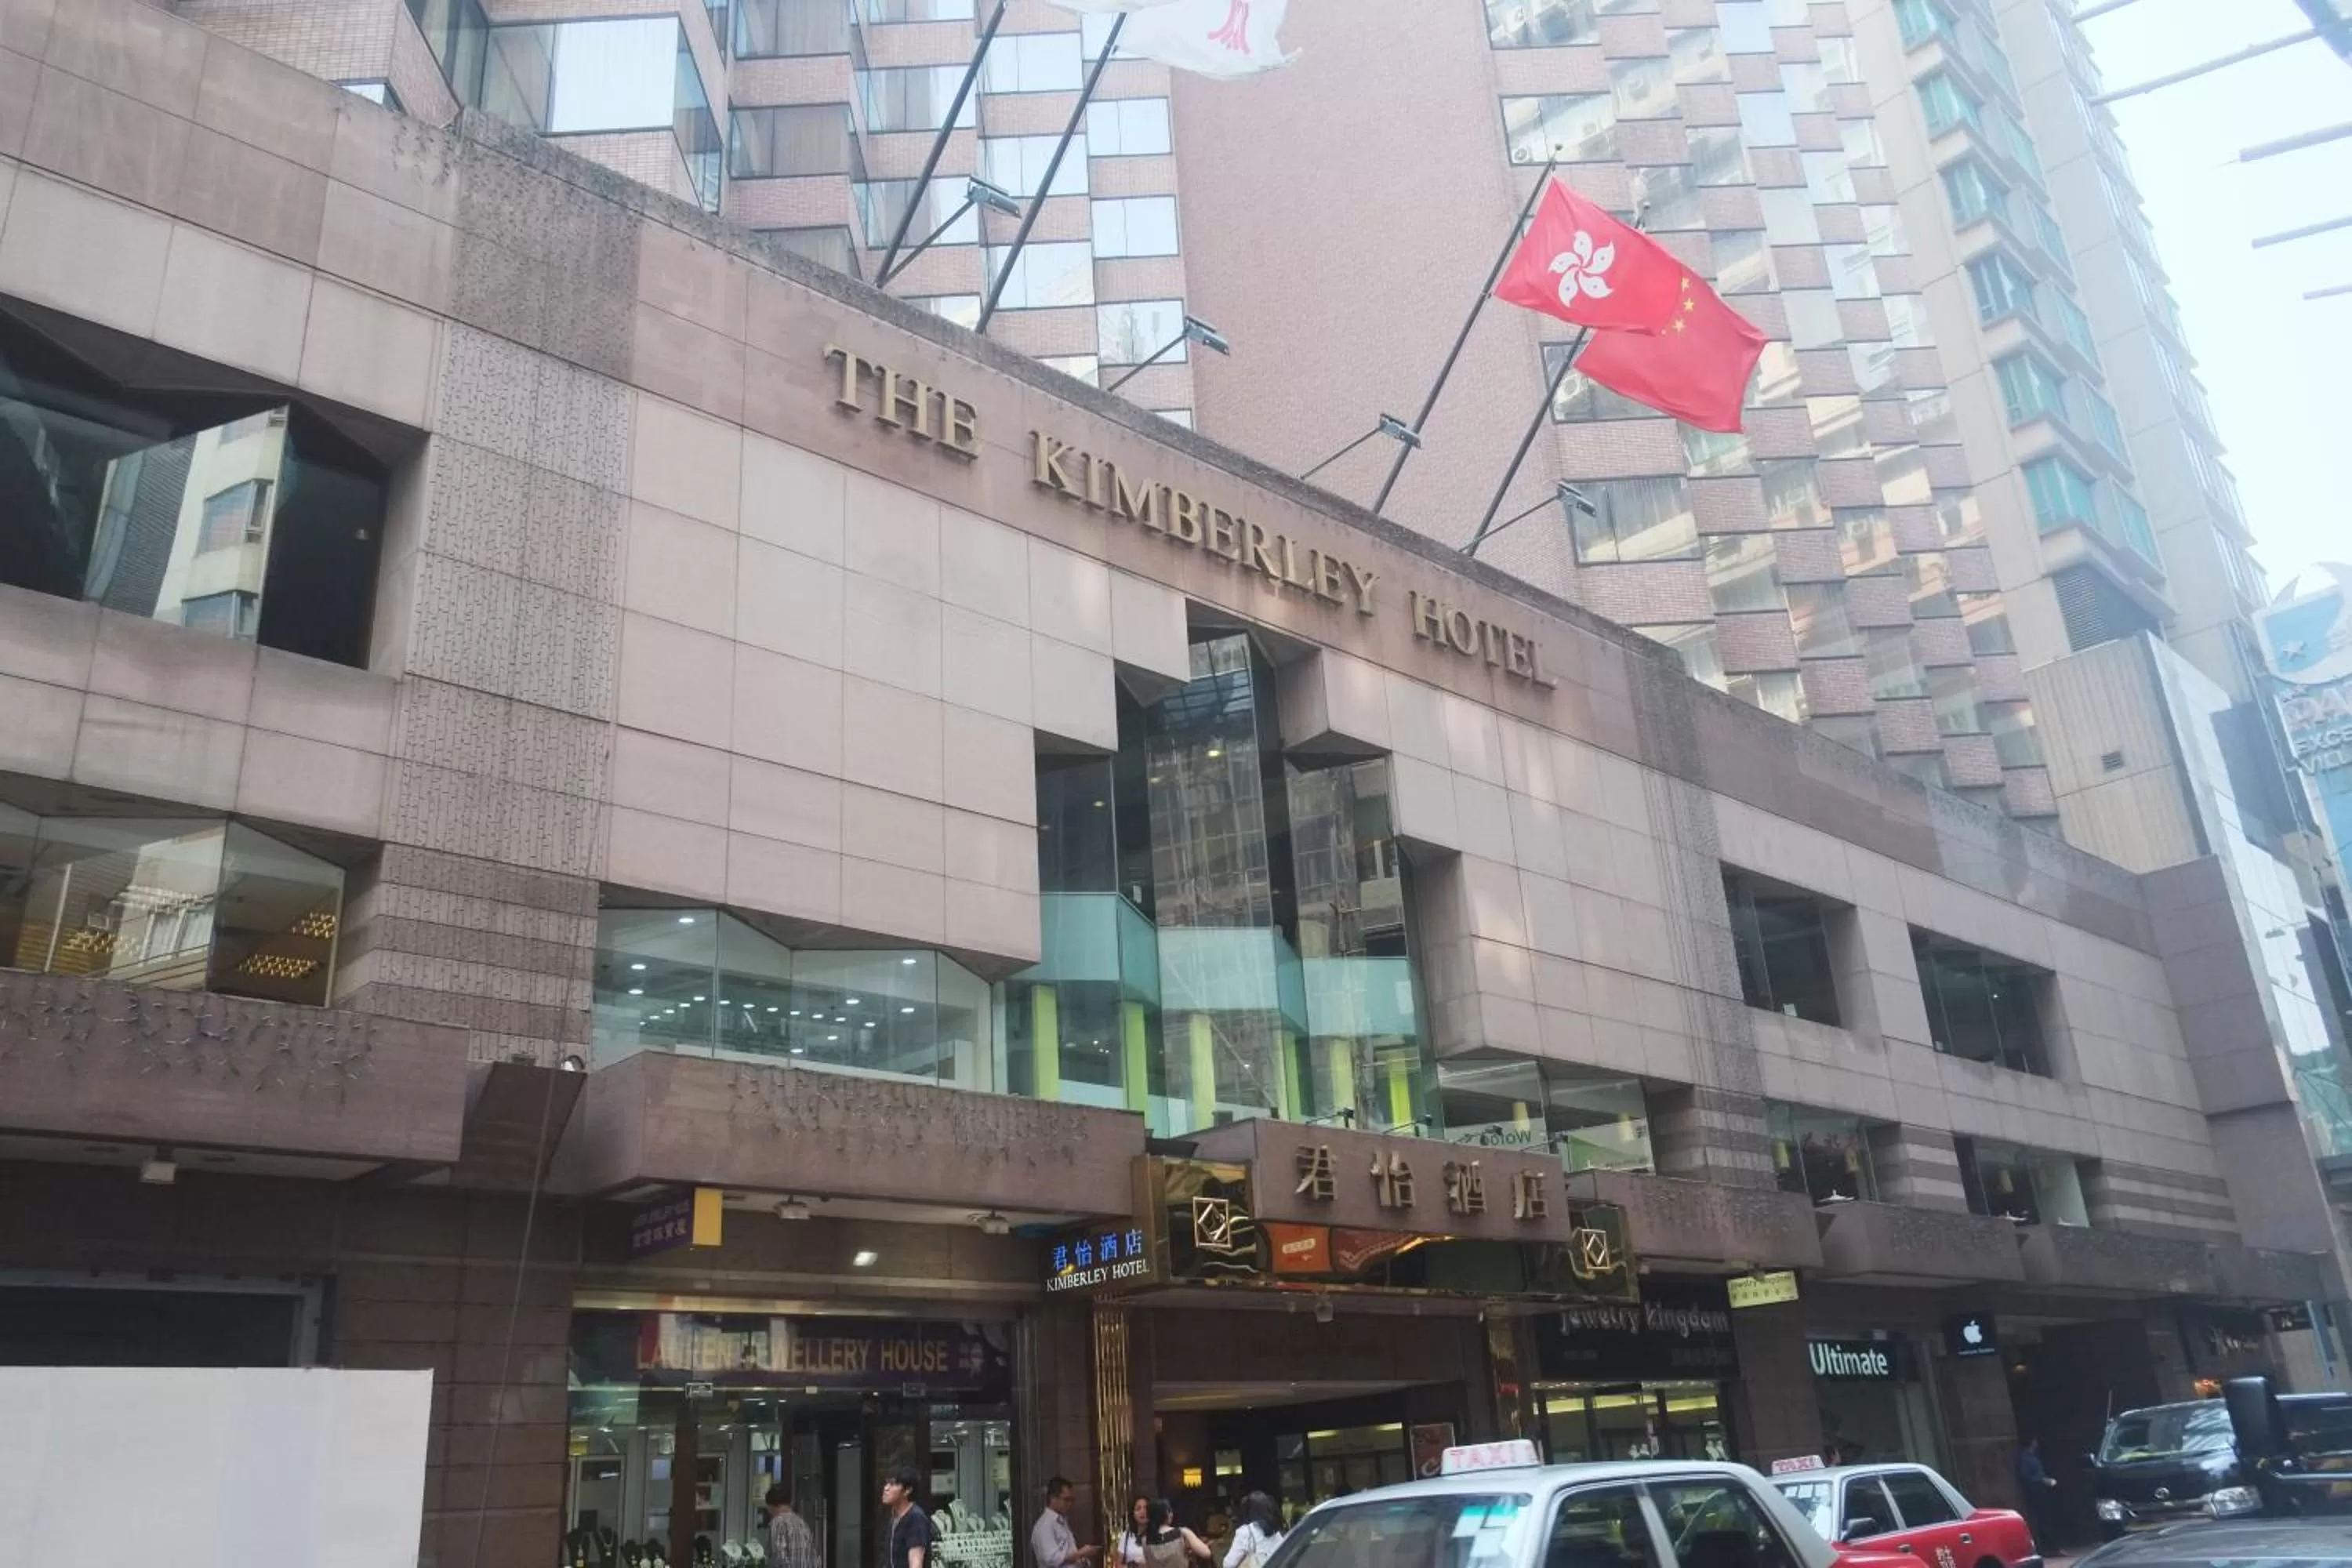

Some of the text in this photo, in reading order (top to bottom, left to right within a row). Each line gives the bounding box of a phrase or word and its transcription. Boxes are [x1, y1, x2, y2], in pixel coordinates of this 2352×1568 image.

[823, 343, 1558, 690] THE KIMBERLEY HOTEL
[1294, 1145, 1549, 1218] 君怡酒店
[1053, 1229, 1143, 1271] 君怡酒店
[1047, 1258, 1150, 1292] KIMBERLEY HOTEL
[880, 1337, 949, 1372] HOUSE
[1809, 1341, 1889, 1375] Ultimate
[1450, 1443, 1516, 1468] TAXI
